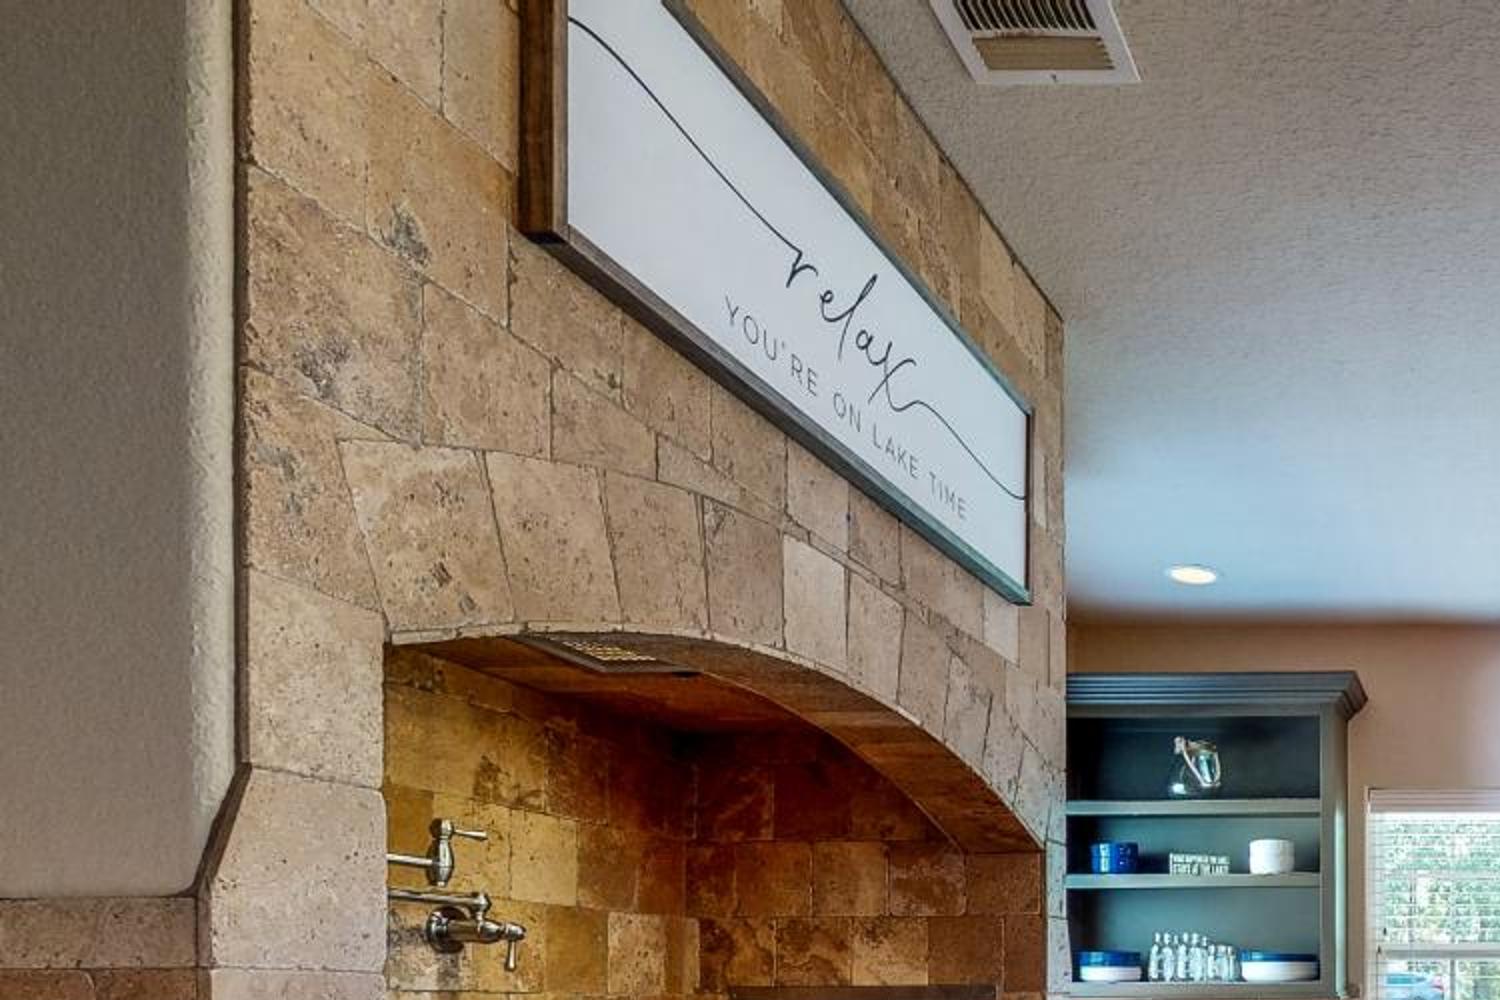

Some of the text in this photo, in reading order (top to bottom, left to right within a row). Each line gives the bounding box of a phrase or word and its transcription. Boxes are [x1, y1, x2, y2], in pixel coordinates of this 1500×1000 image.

[724, 296, 967, 519] YOU'RE ON LAKE TIME
[785, 249, 917, 412] relax
